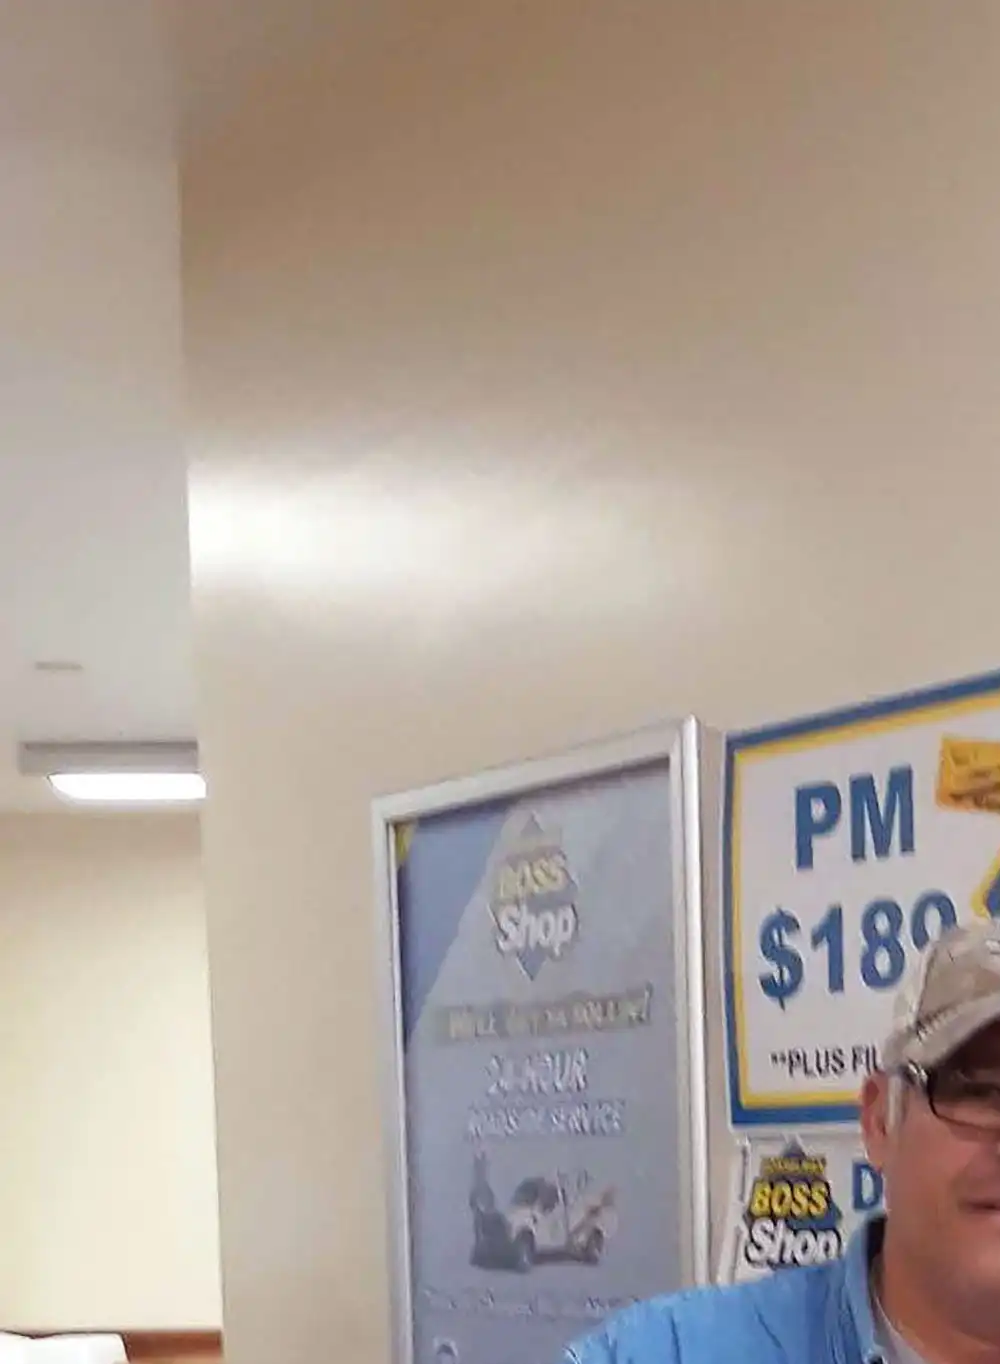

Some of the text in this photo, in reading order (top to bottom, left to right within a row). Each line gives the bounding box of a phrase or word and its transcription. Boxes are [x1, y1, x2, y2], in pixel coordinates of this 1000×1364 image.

[796, 763, 914, 870] PM
[495, 903, 575, 957] Shop
[752, 1179, 829, 1219] BOSS
